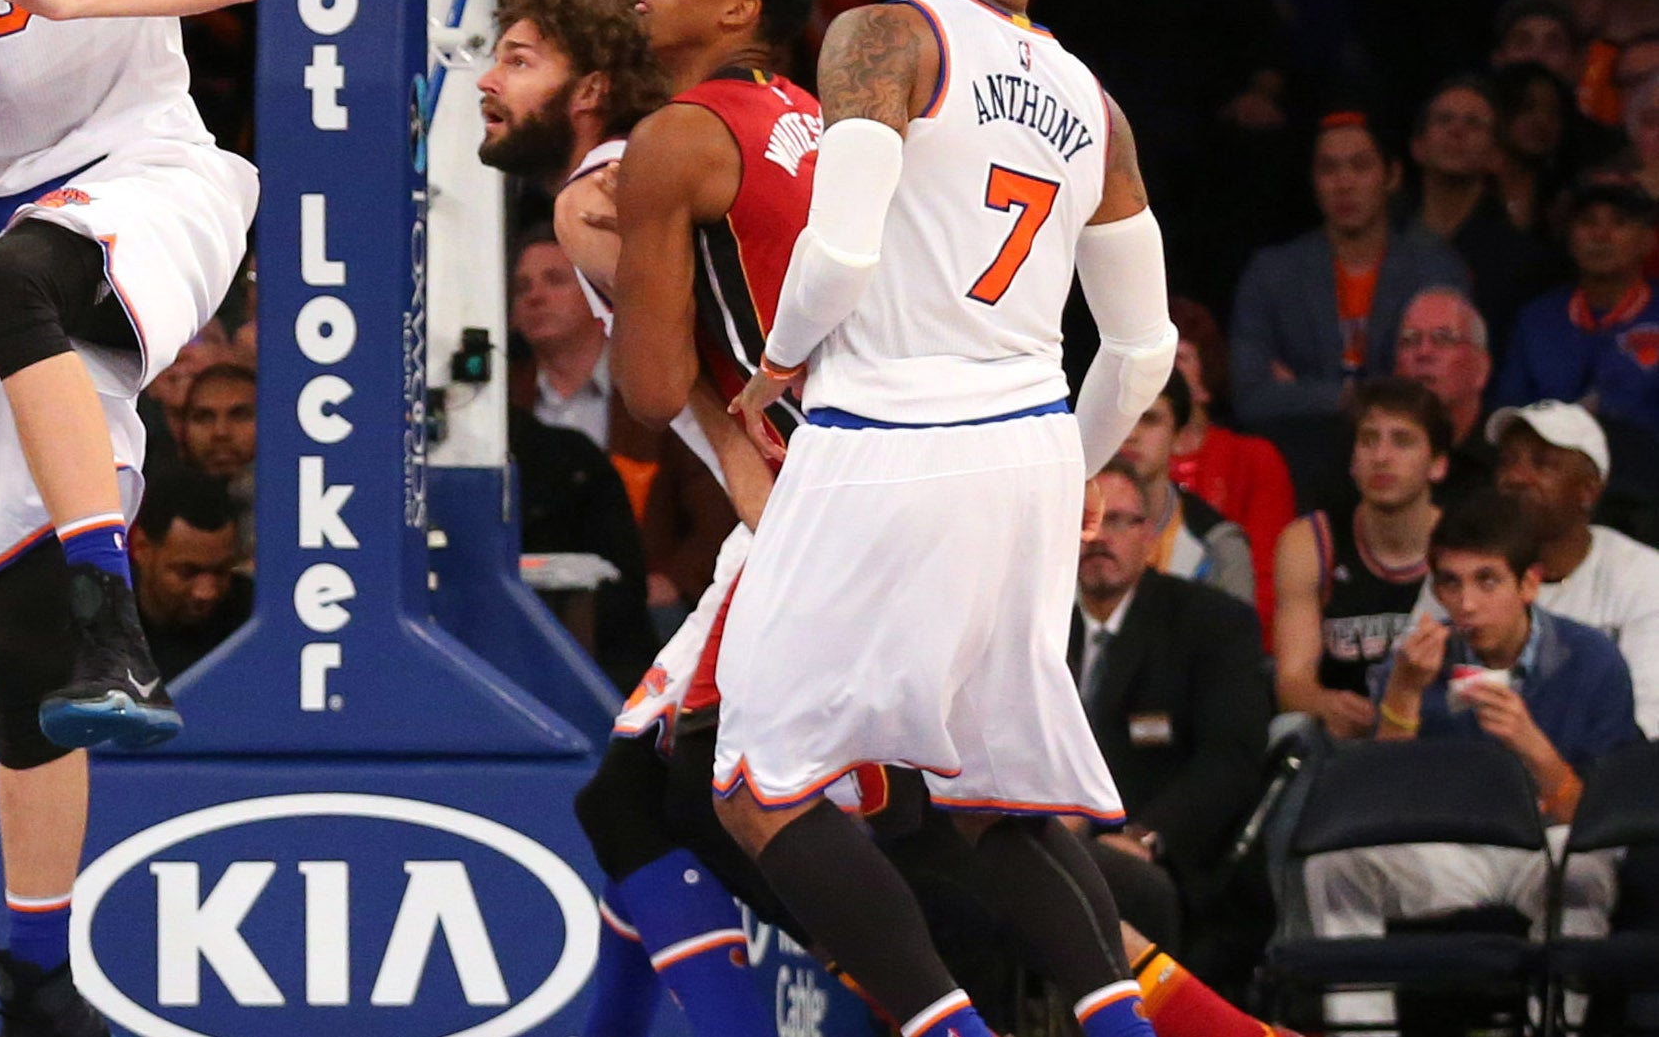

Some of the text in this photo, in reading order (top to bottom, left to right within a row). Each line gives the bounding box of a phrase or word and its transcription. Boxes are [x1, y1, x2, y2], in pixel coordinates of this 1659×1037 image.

[972, 74, 1093, 163] ANTHONY
[965, 162, 1061, 306] 7
[149, 860, 510, 1007] KIA
